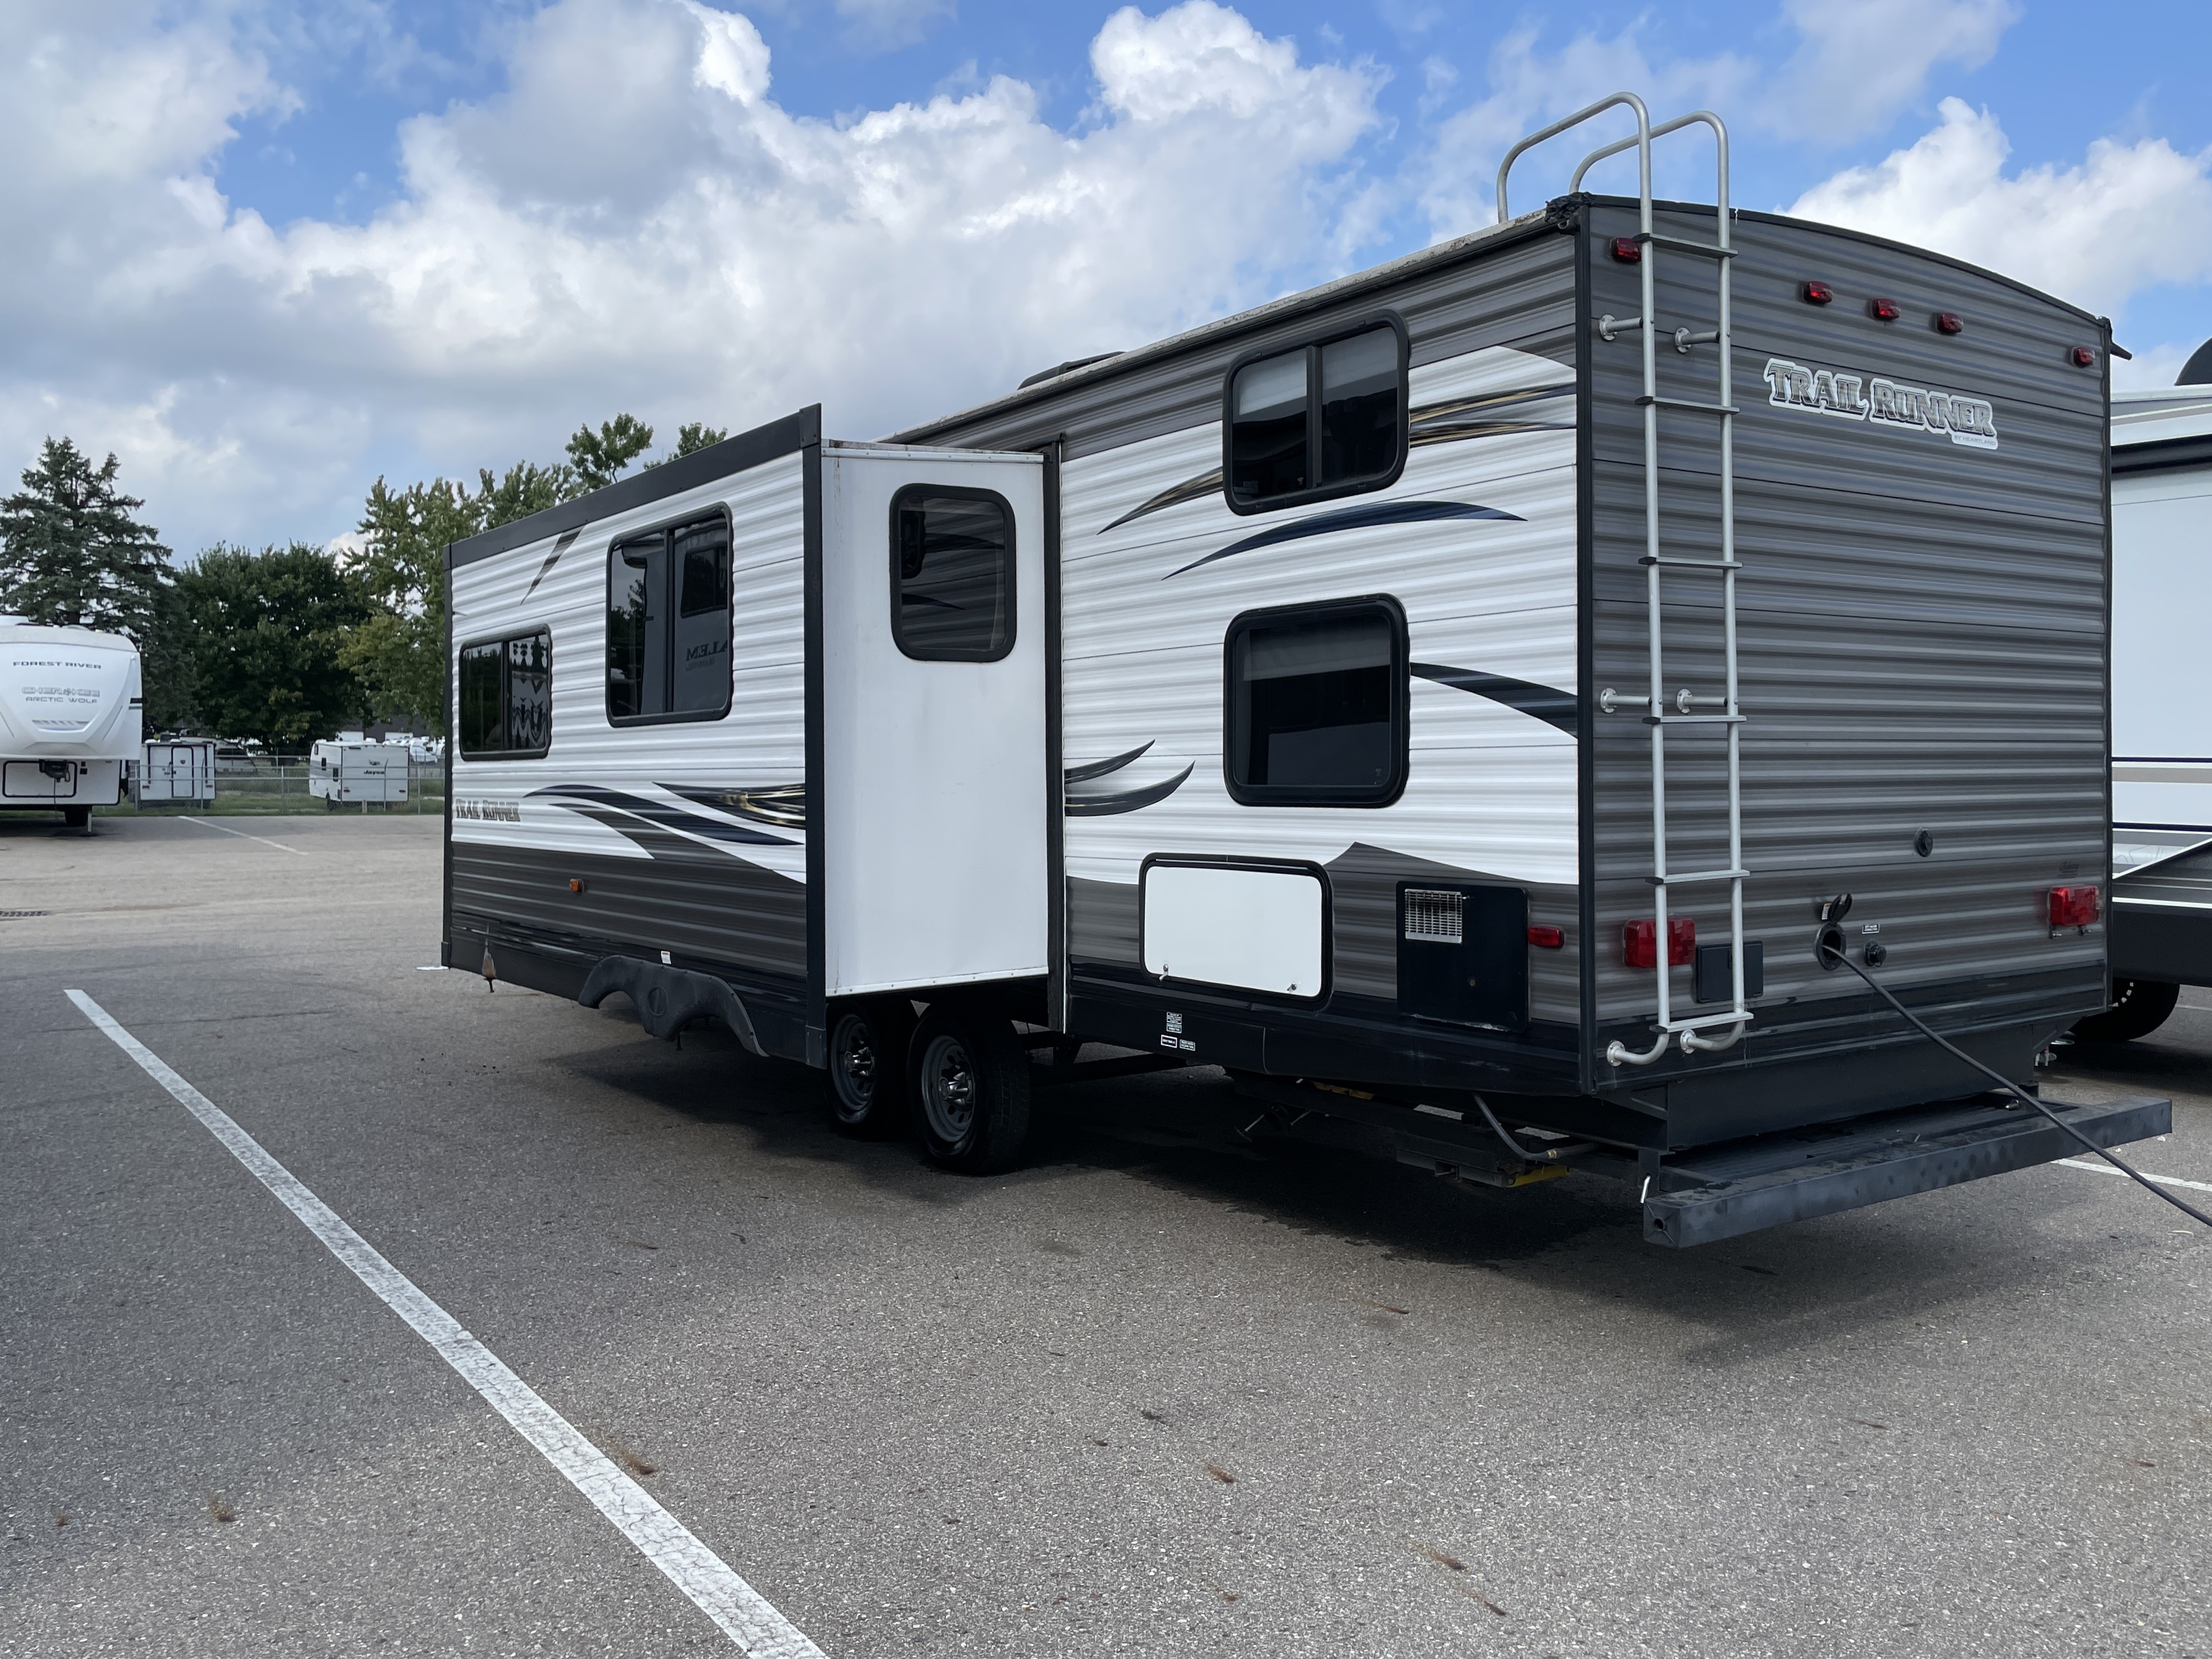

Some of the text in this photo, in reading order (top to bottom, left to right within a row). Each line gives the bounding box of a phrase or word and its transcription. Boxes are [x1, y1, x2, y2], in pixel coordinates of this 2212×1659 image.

[1767, 363, 1996, 437] TRAIL RUNNER
[1962, 436, 1997, 446] HEARTLAND
[456, 798, 481, 820] TRAIL
